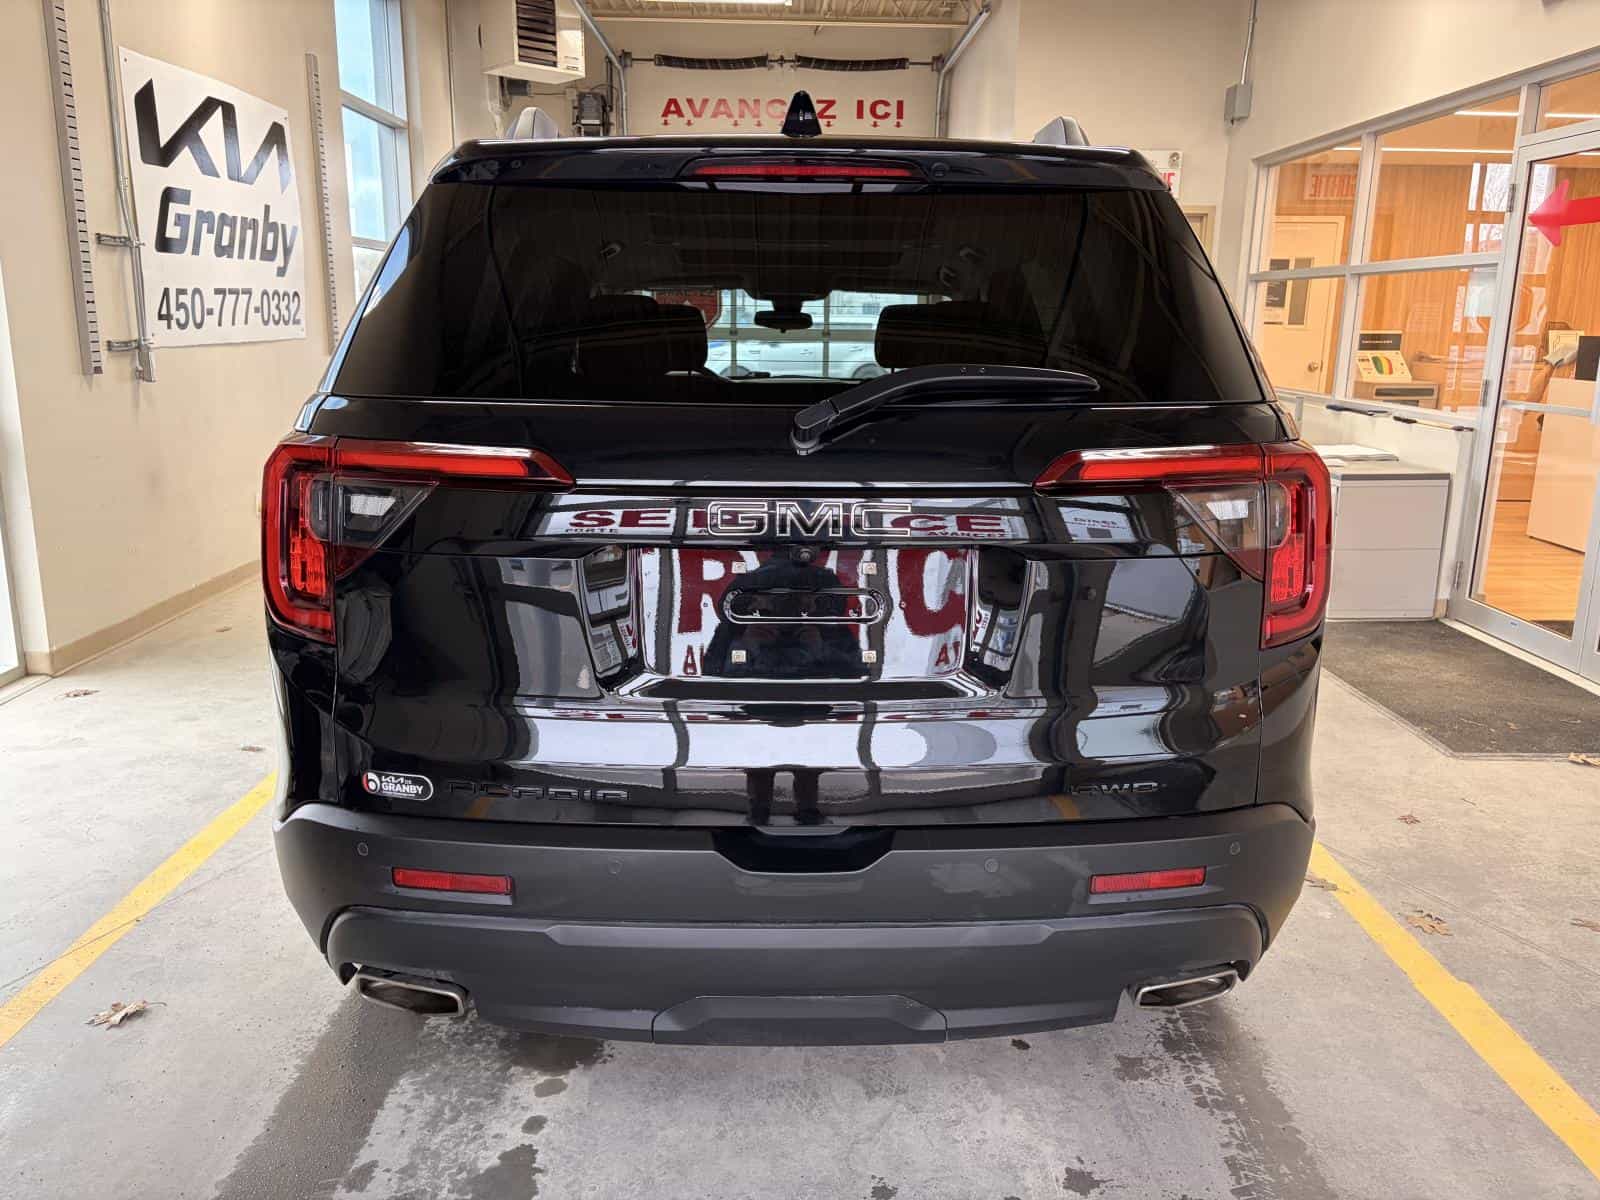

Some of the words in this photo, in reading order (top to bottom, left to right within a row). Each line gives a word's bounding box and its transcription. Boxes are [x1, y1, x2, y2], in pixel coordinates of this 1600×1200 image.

[661, 97, 837, 119] AVANCZ
[856, 99, 905, 120] ICI
[134, 78, 292, 195] KIA
[155, 186, 298, 277] Granby
[157, 287, 301, 330] 450-777-0332
[708, 501, 912, 537] GMC
[381, 776, 404, 784] KIA
[381, 782, 424, 794] GRANBY
